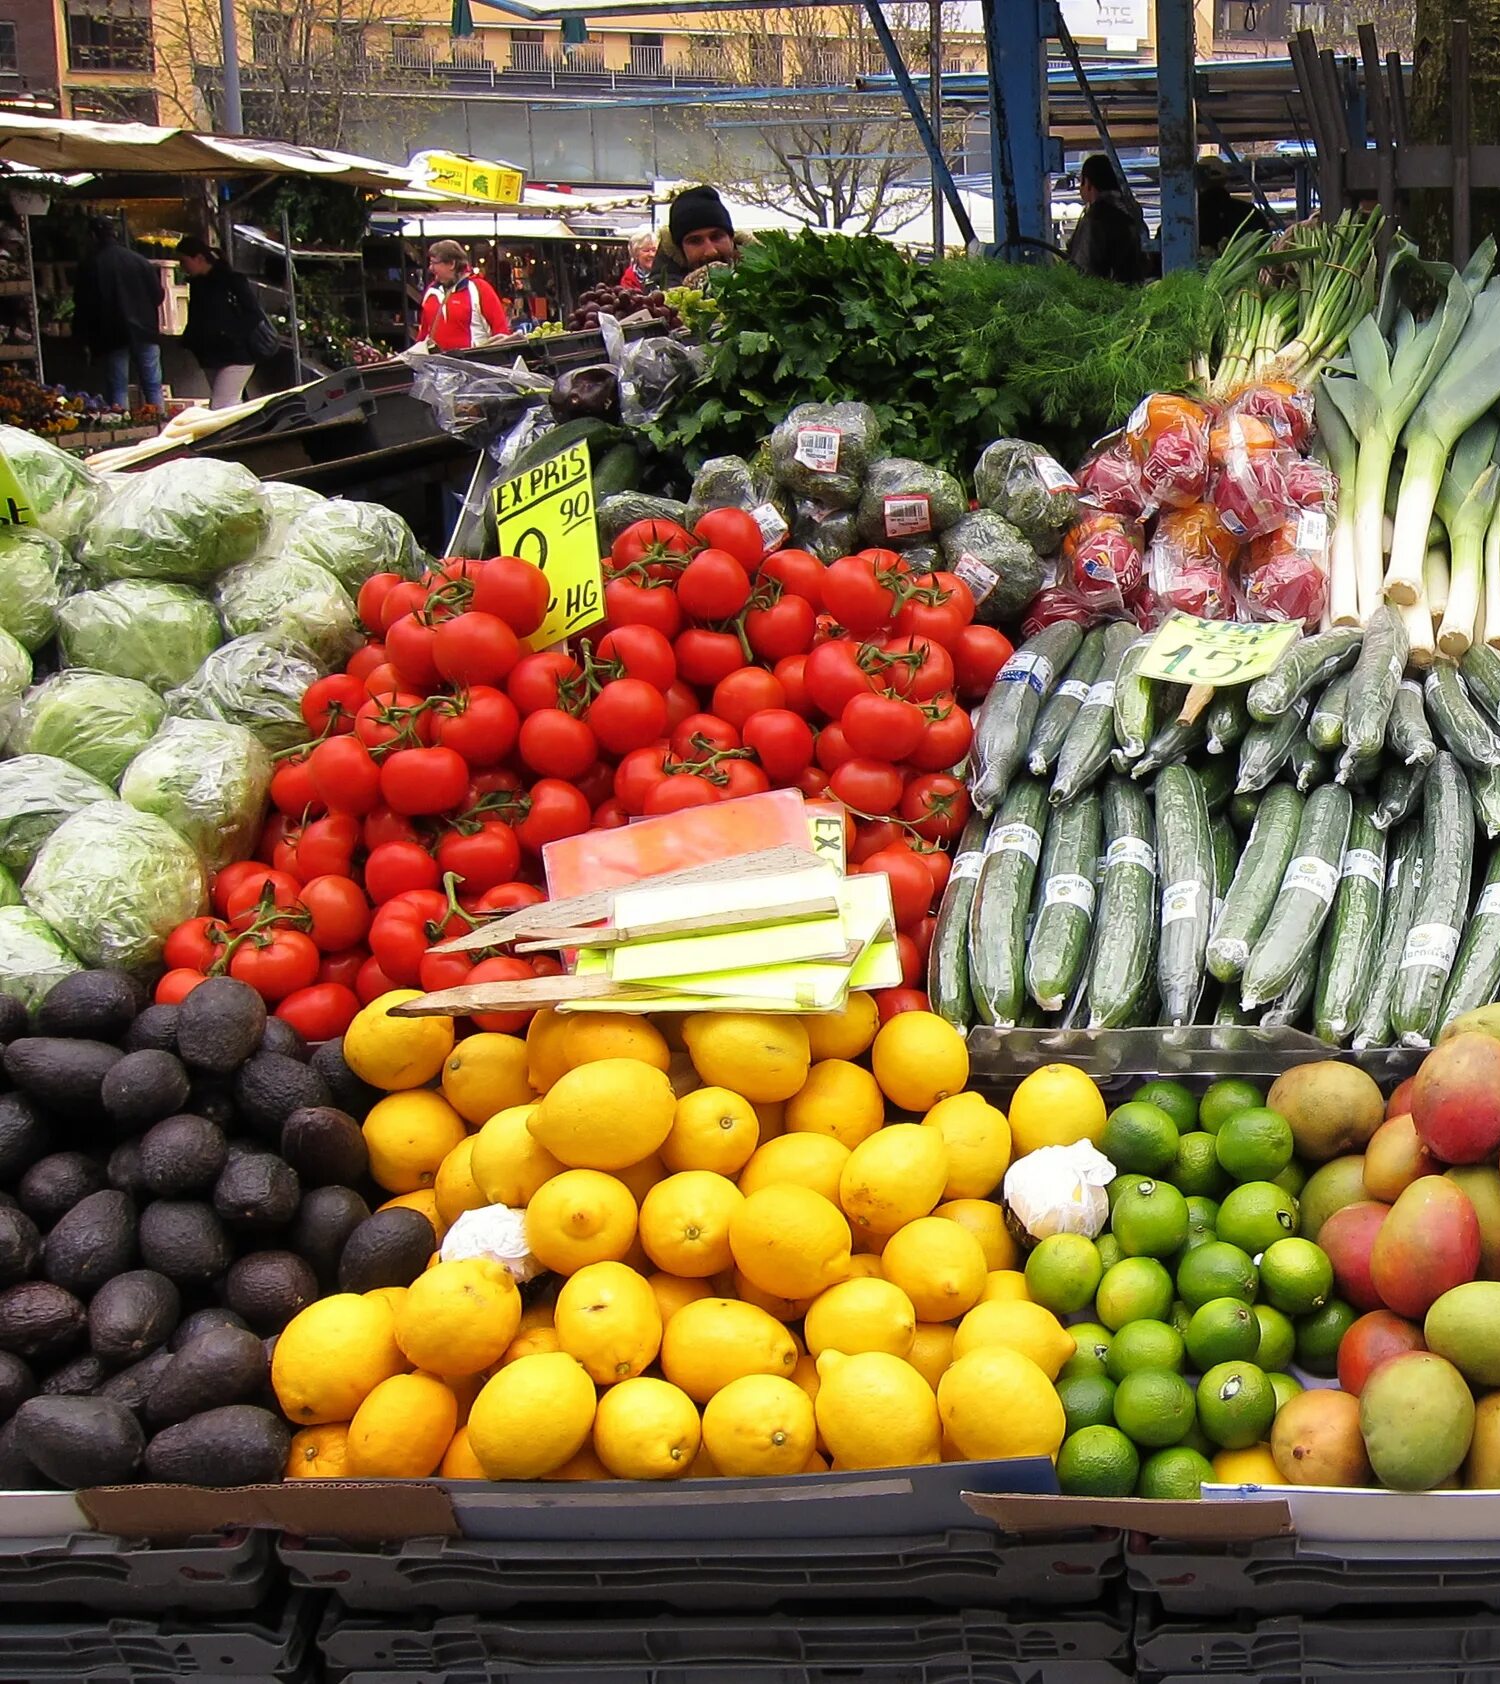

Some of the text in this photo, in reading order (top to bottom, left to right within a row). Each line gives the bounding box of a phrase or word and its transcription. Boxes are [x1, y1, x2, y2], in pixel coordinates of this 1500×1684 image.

[559, 490, 591, 527] 90
[565, 579, 599, 618] HG
[814, 818, 843, 852] EX
